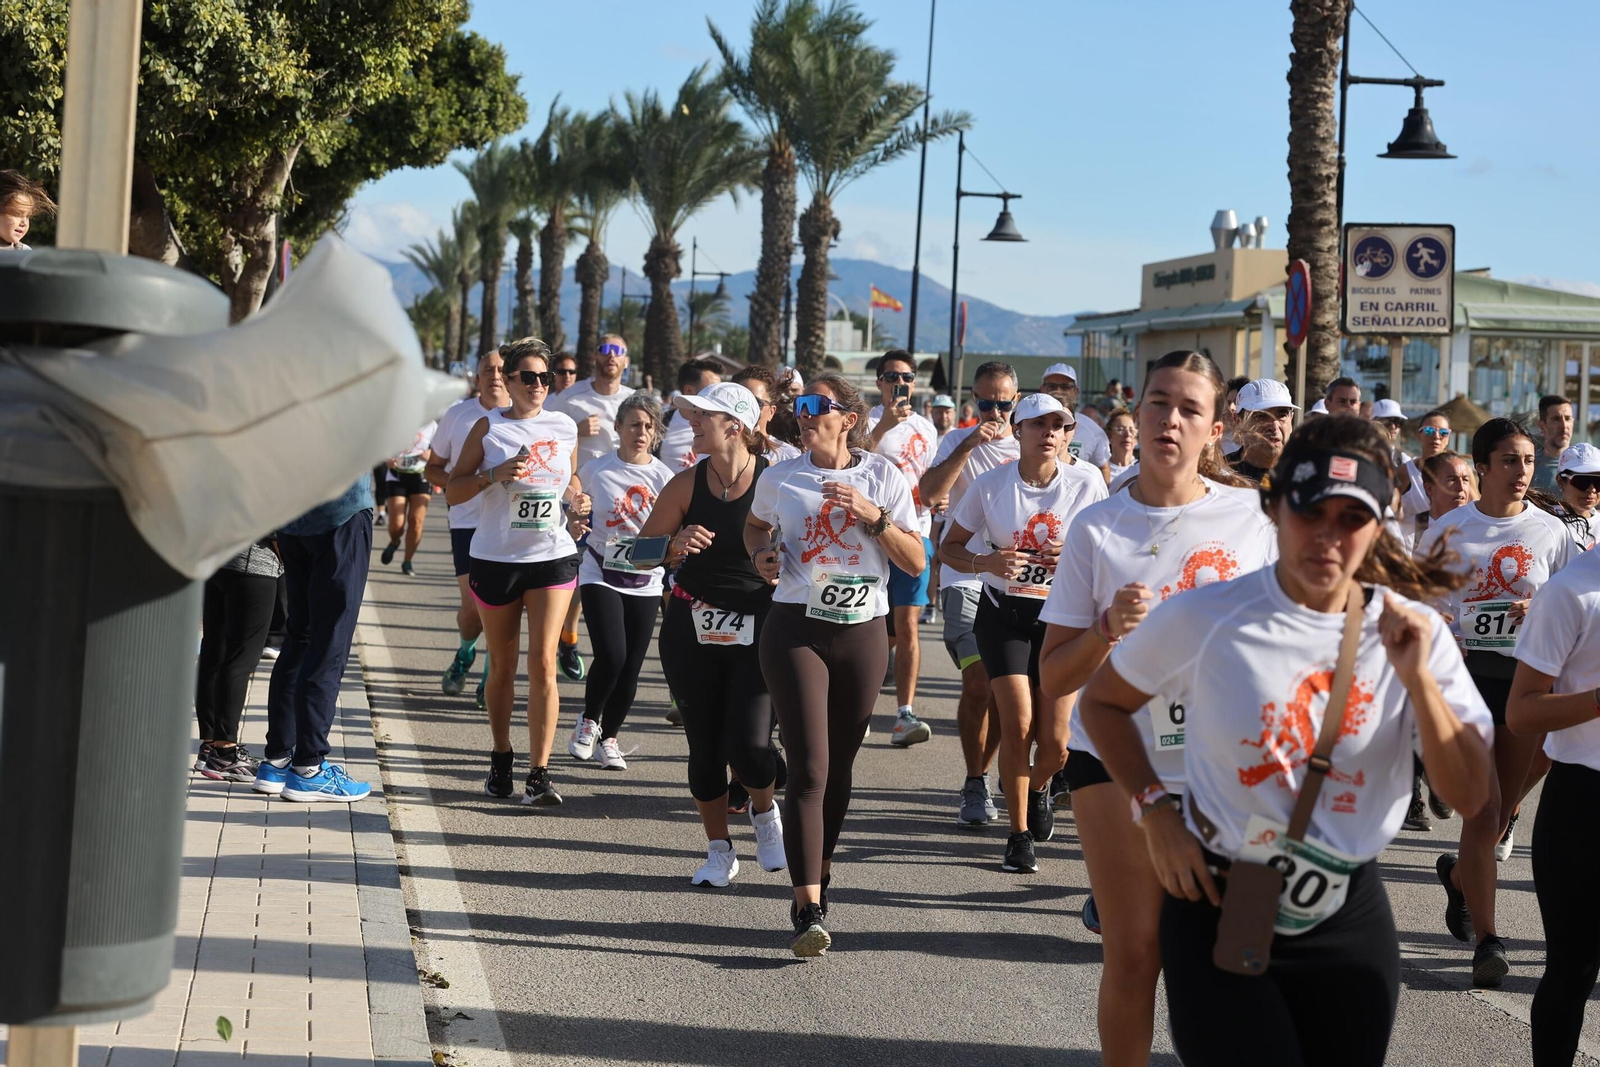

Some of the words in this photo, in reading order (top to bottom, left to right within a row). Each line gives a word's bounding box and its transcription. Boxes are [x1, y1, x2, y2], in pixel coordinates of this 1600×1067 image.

[1351, 287, 1396, 295] BICICLETAS
[1360, 302, 1379, 311] EN
[1385, 302, 1439, 312] CARRIL
[1352, 314, 1447, 327] SEÑALIZADO
[518, 501, 552, 518] 812
[1016, 565, 1053, 585] 38
[821, 585, 869, 607] 622
[702, 610, 744, 631] 374
[1161, 736, 1176, 745] 024
